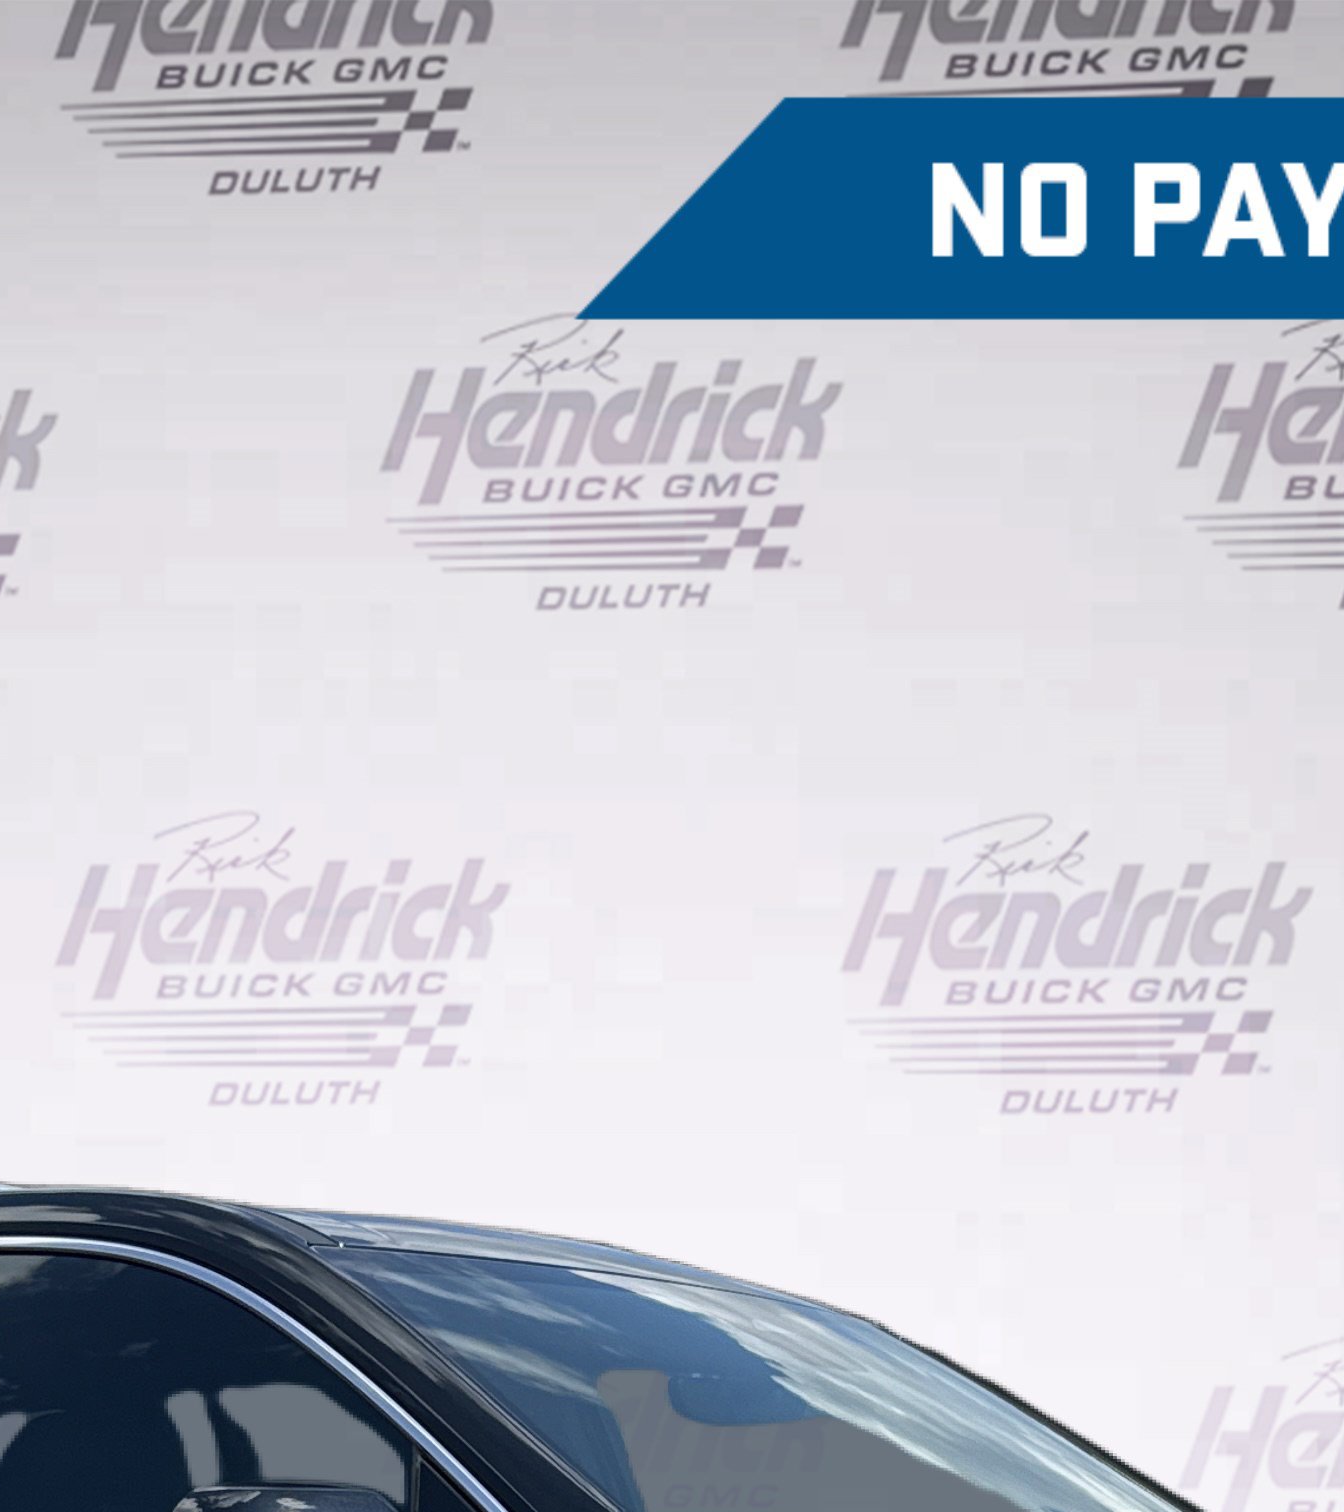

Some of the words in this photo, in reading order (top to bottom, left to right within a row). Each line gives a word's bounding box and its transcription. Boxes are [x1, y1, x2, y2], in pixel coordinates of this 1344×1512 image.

[156, 59, 317, 90] BUICK
[333, 55, 449, 83] GMC
[945, 48, 1111, 79] BUICK
[1128, 44, 1249, 73] GMC
[208, 165, 382, 196] DULUTH
[379, 356, 844, 506] Hendrick
[482, 474, 645, 504] BUICK
[662, 472, 780, 499] GMC
[535, 583, 711, 611] DULUTH
[54, 857, 512, 1001] Hendrick
[841, 861, 1315, 1008] Hendrick
[155, 972, 317, 999] BUICK
[333, 971, 448, 997] GMC
[944, 978, 1111, 1006] BUICK
[1128, 976, 1249, 1004] GMC
[207, 1080, 381, 1106] DULUTH
[999, 1088, 1179, 1115] DULUTH
